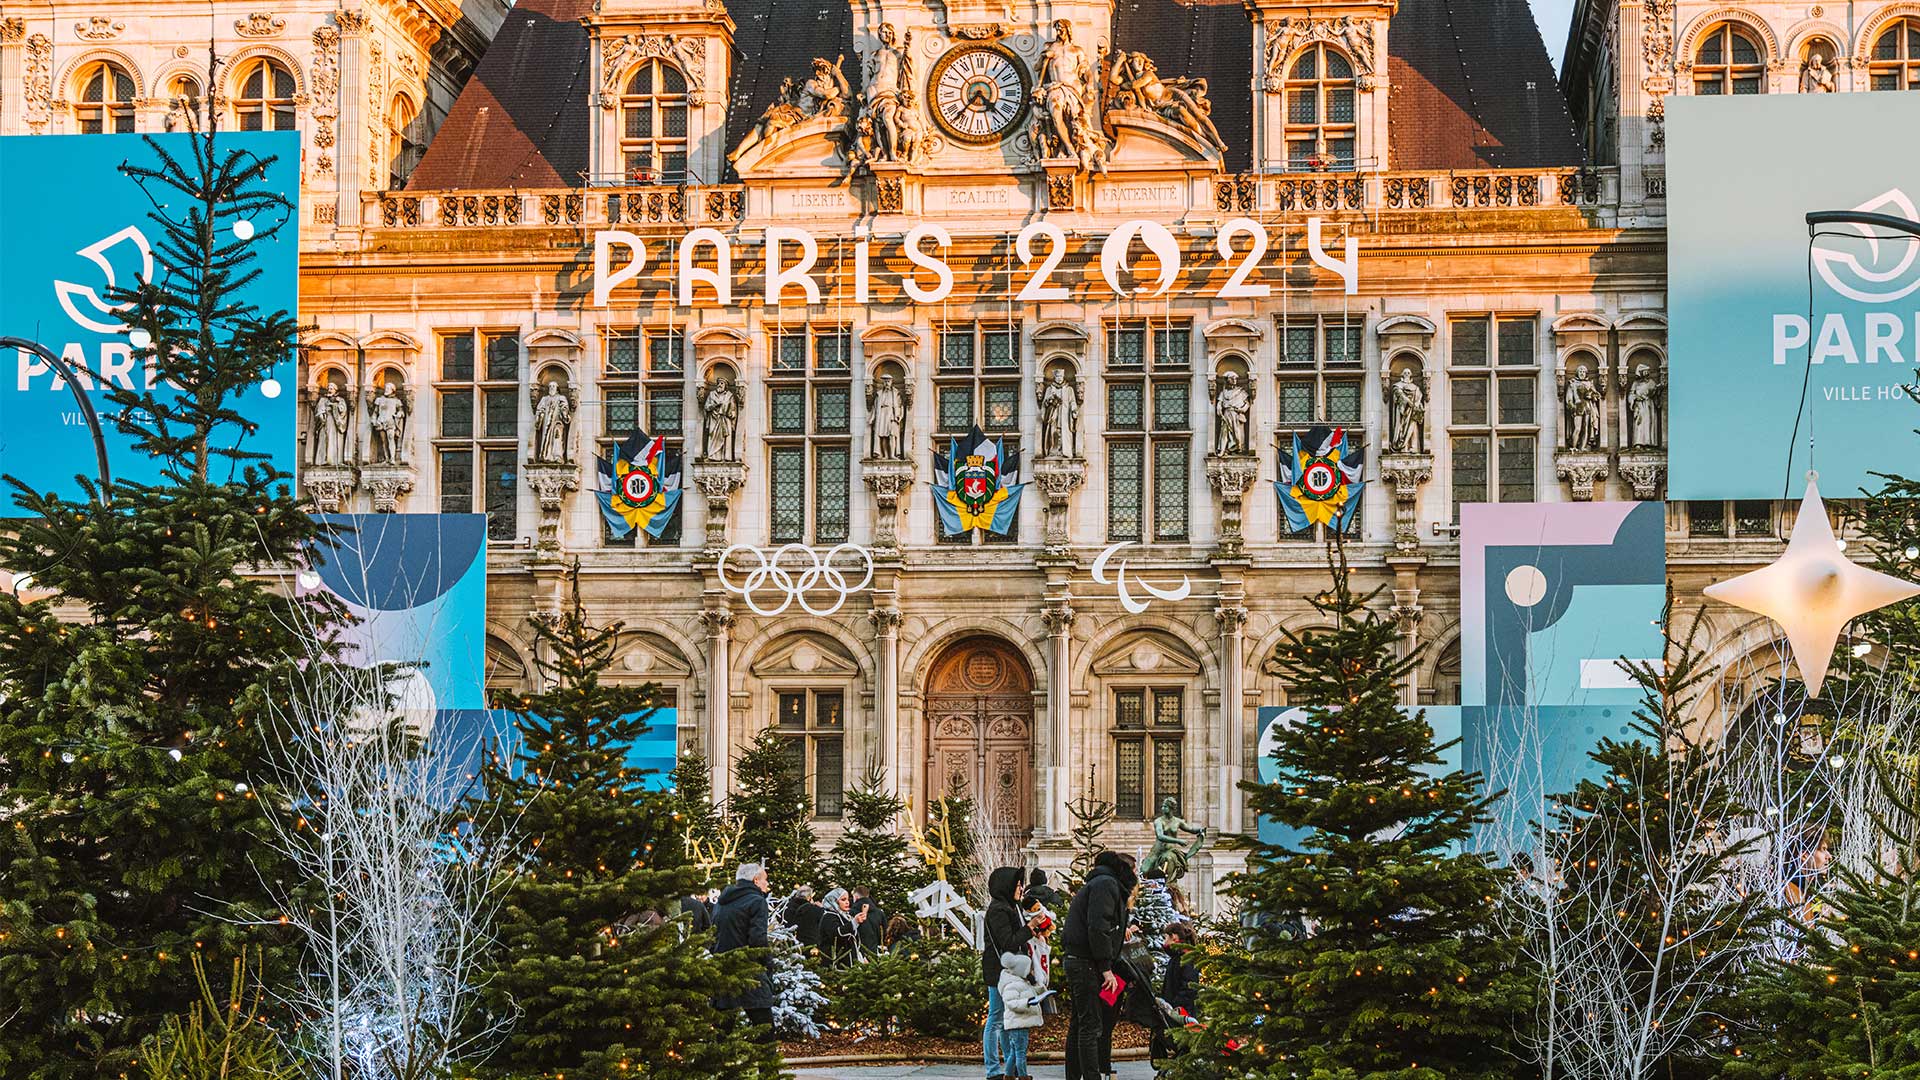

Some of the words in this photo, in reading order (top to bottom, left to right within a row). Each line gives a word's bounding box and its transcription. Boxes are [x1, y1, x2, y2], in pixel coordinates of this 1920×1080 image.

[791, 191, 845, 207] LIBERTÉ
[1102, 184, 1177, 202] FRATERNITÉ
[1015, 217, 1359, 301] 2024
[1823, 386, 1872, 401] VILLE
[62, 411, 105, 426] VILE
[631, 477, 648, 496] RF
